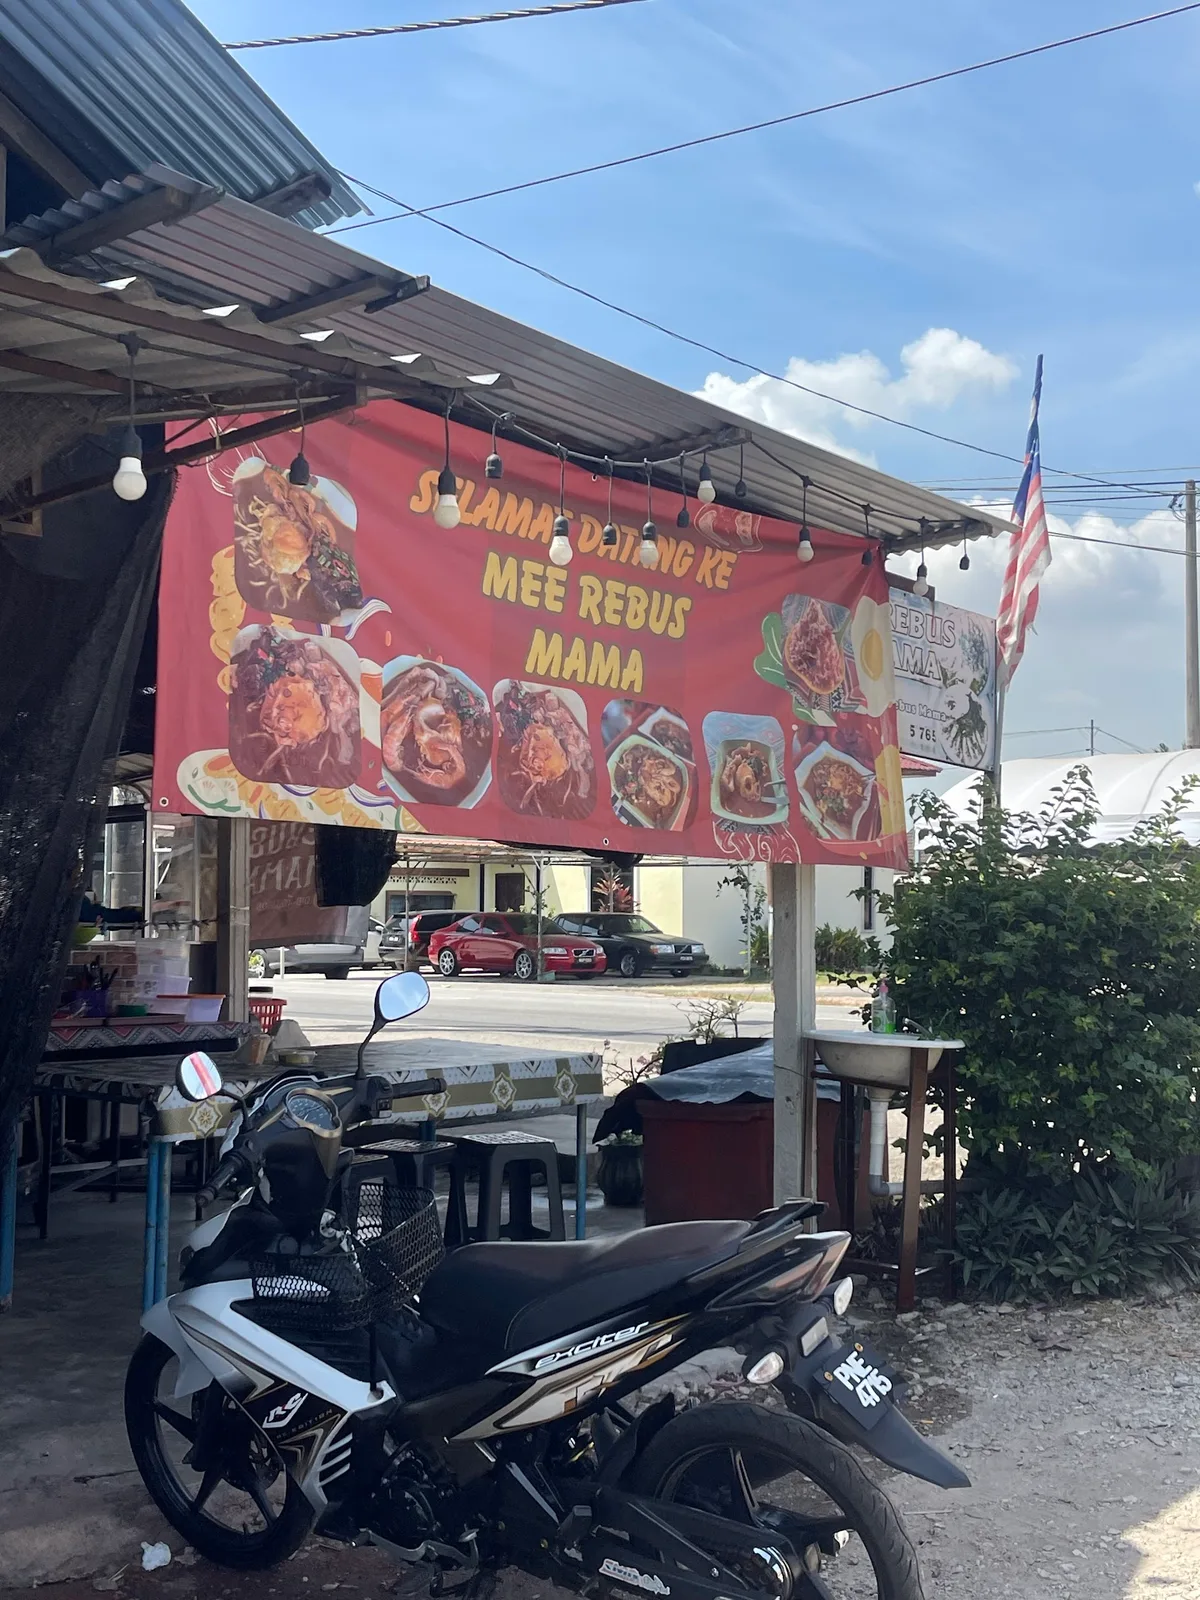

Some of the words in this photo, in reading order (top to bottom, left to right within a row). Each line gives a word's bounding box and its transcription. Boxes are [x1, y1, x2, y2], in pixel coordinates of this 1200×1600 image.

[410, 469, 574, 544] SLAMA
[577, 513, 695, 578] DATNG
[695, 546, 738, 590] KE
[482, 551, 569, 613] MEE
[578, 574, 692, 639] REBUS
[524, 628, 645, 693] MAMA
[918, 703, 947, 722] Mama
[535, 1321, 649, 1369] exciter
[833, 1350, 873, 1391] PNE
[855, 1368, 893, 1408] 4715
